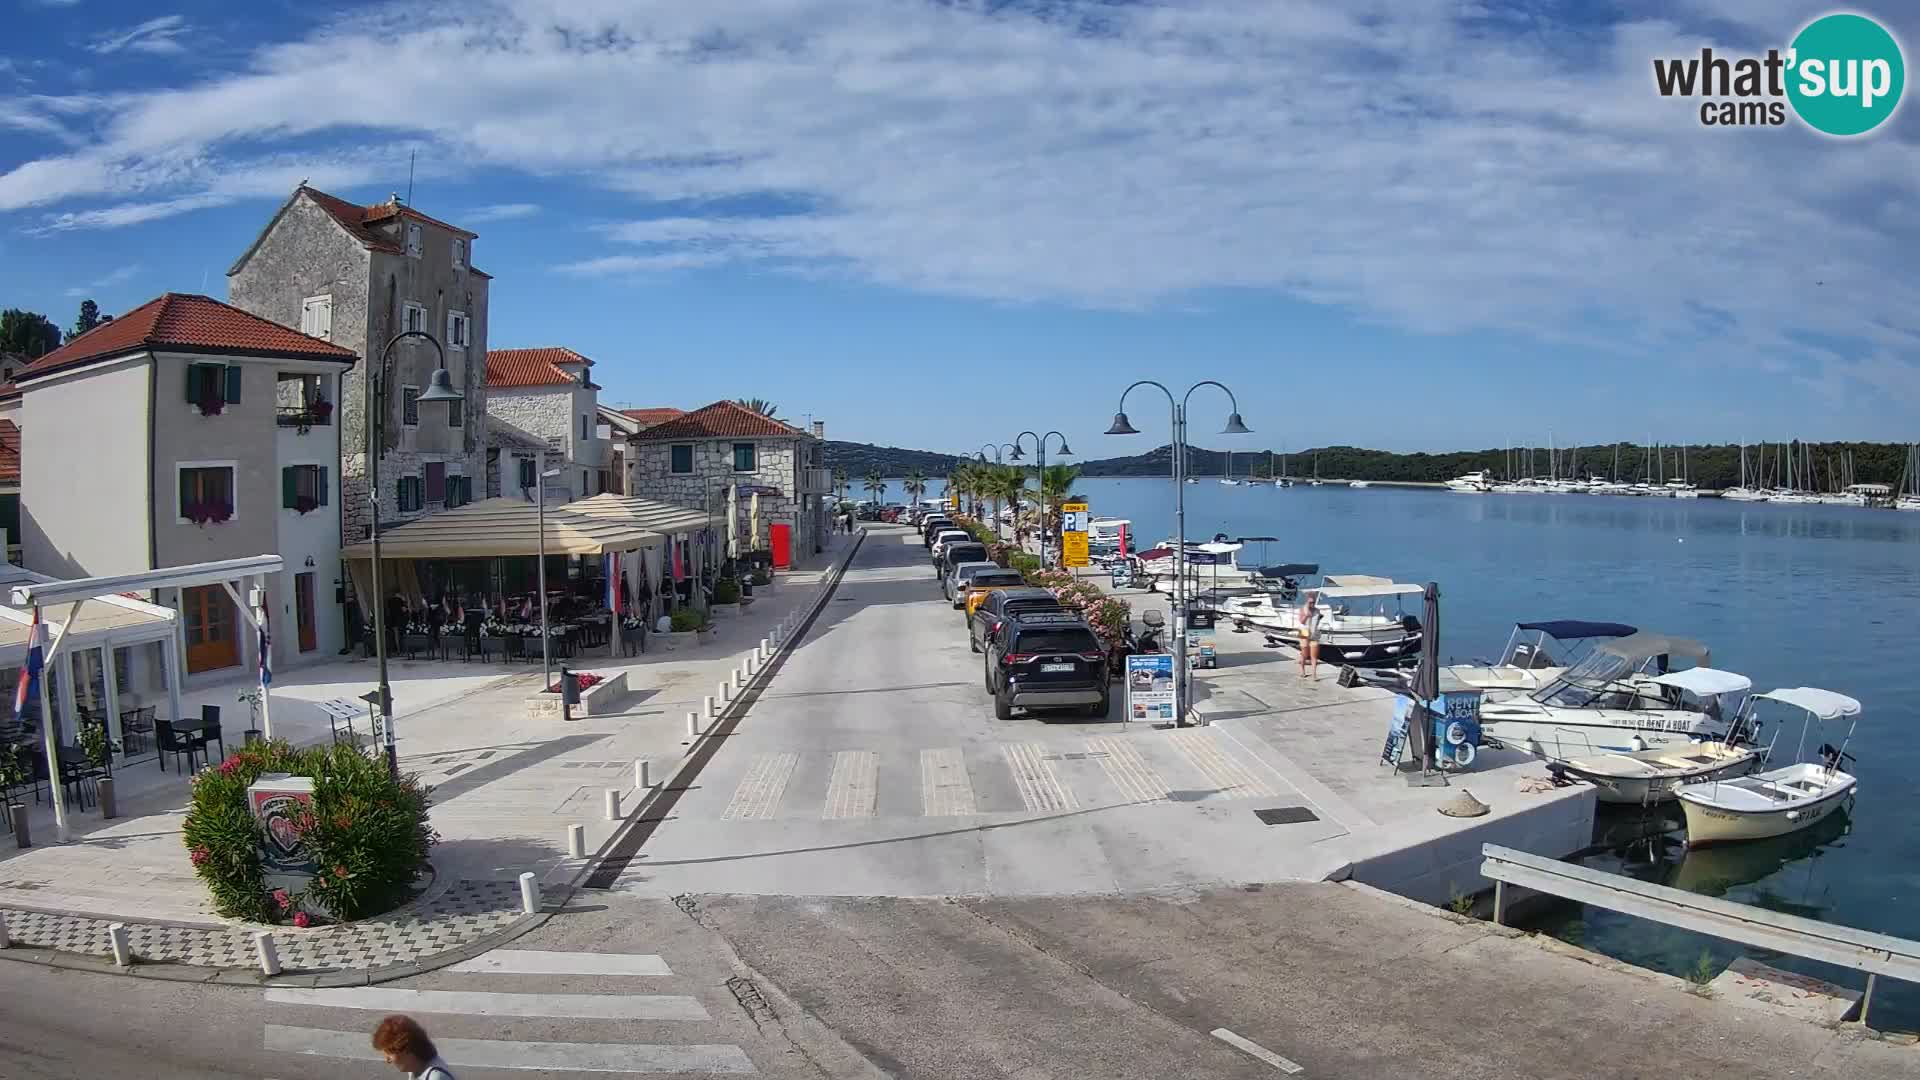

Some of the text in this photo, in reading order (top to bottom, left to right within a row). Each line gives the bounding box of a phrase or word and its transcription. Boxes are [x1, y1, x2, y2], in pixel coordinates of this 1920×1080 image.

[1065, 514, 1075, 530] P
[1447, 696, 1478, 710] RENT
[1446, 709, 1478, 719] A BOAT
[1646, 720, 1665, 729] RENT
[1666, 720, 1672, 729] A
[1672, 720, 1691, 731] BOAT
